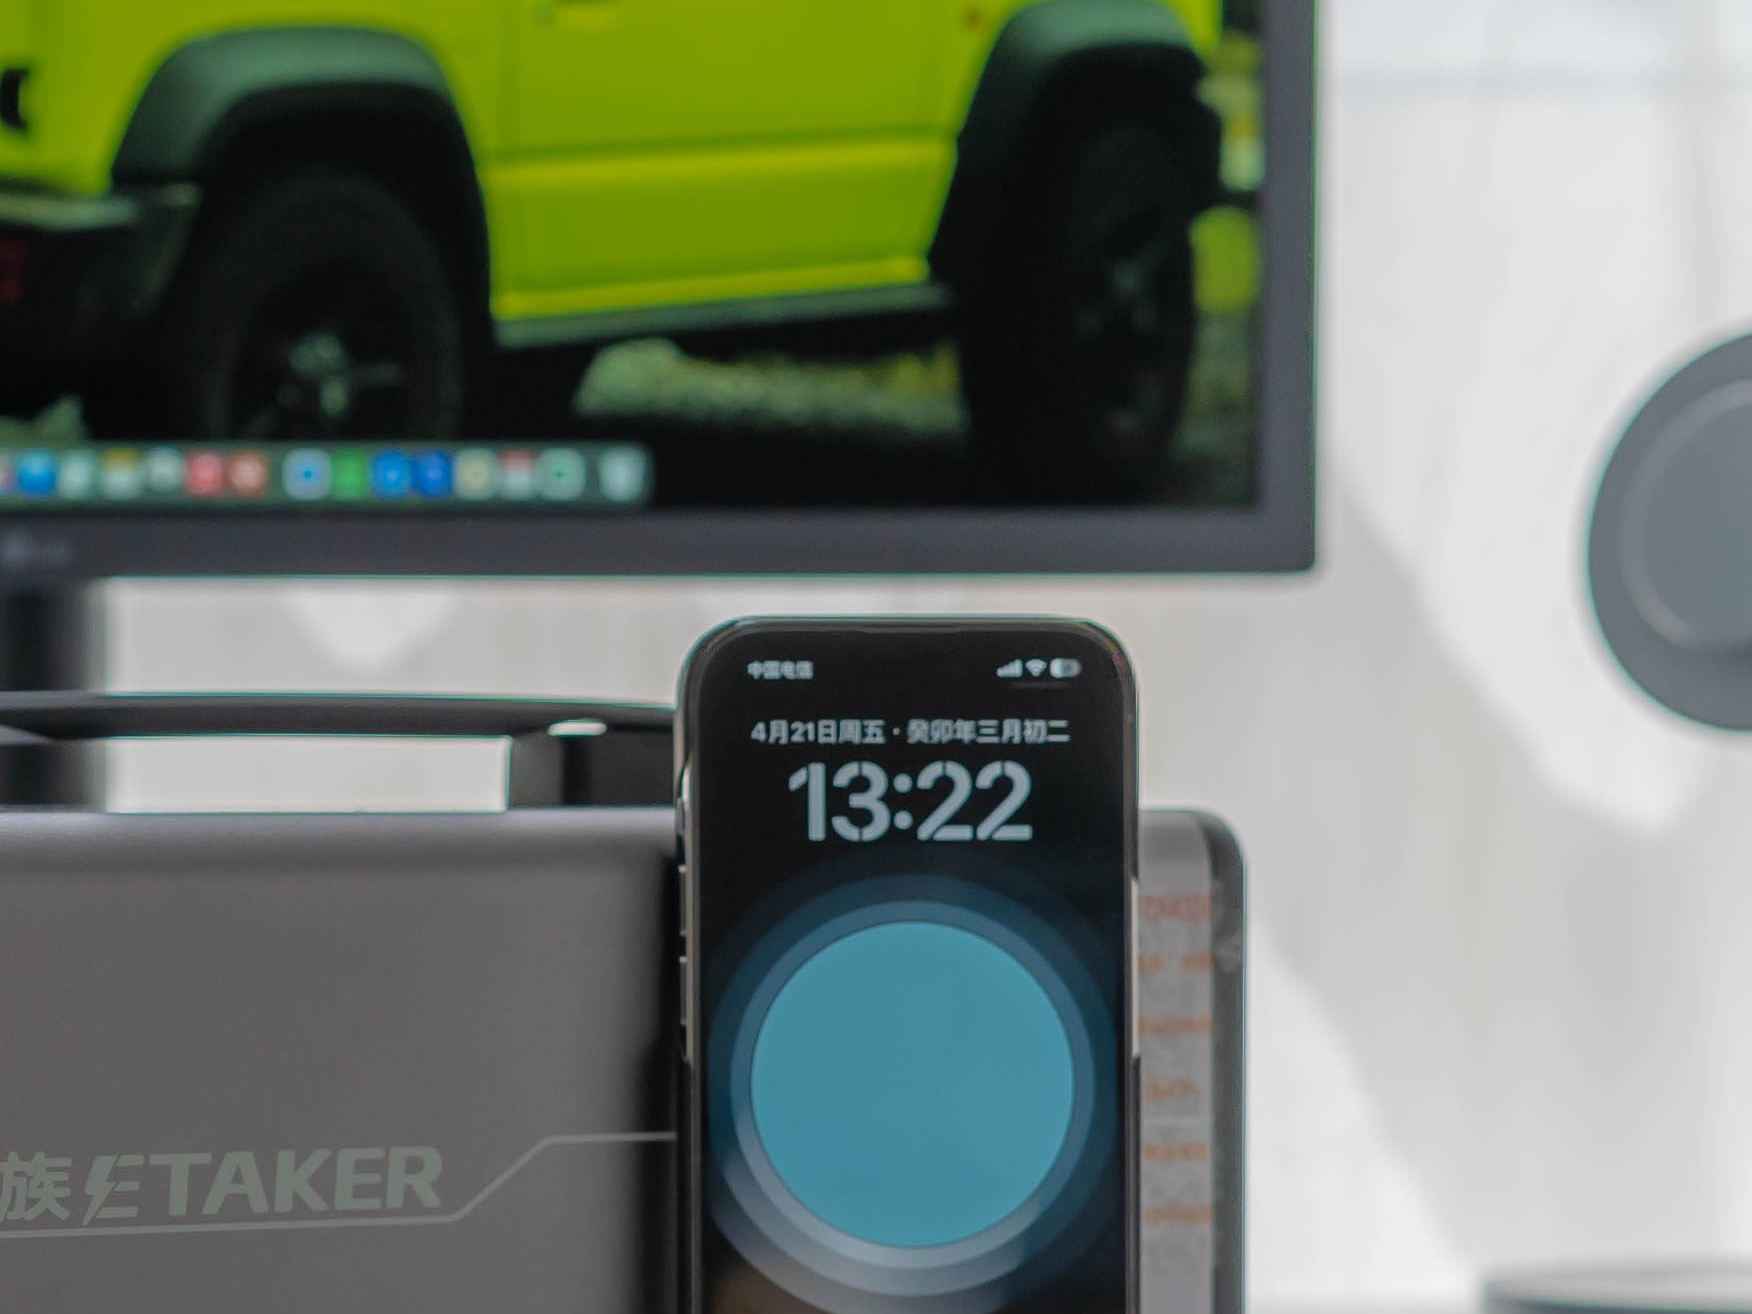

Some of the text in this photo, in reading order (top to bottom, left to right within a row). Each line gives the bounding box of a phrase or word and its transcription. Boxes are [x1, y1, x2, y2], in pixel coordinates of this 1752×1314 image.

[750, 719, 886, 744] 4月21日周五
[788, 760, 1033, 842] 13:22
